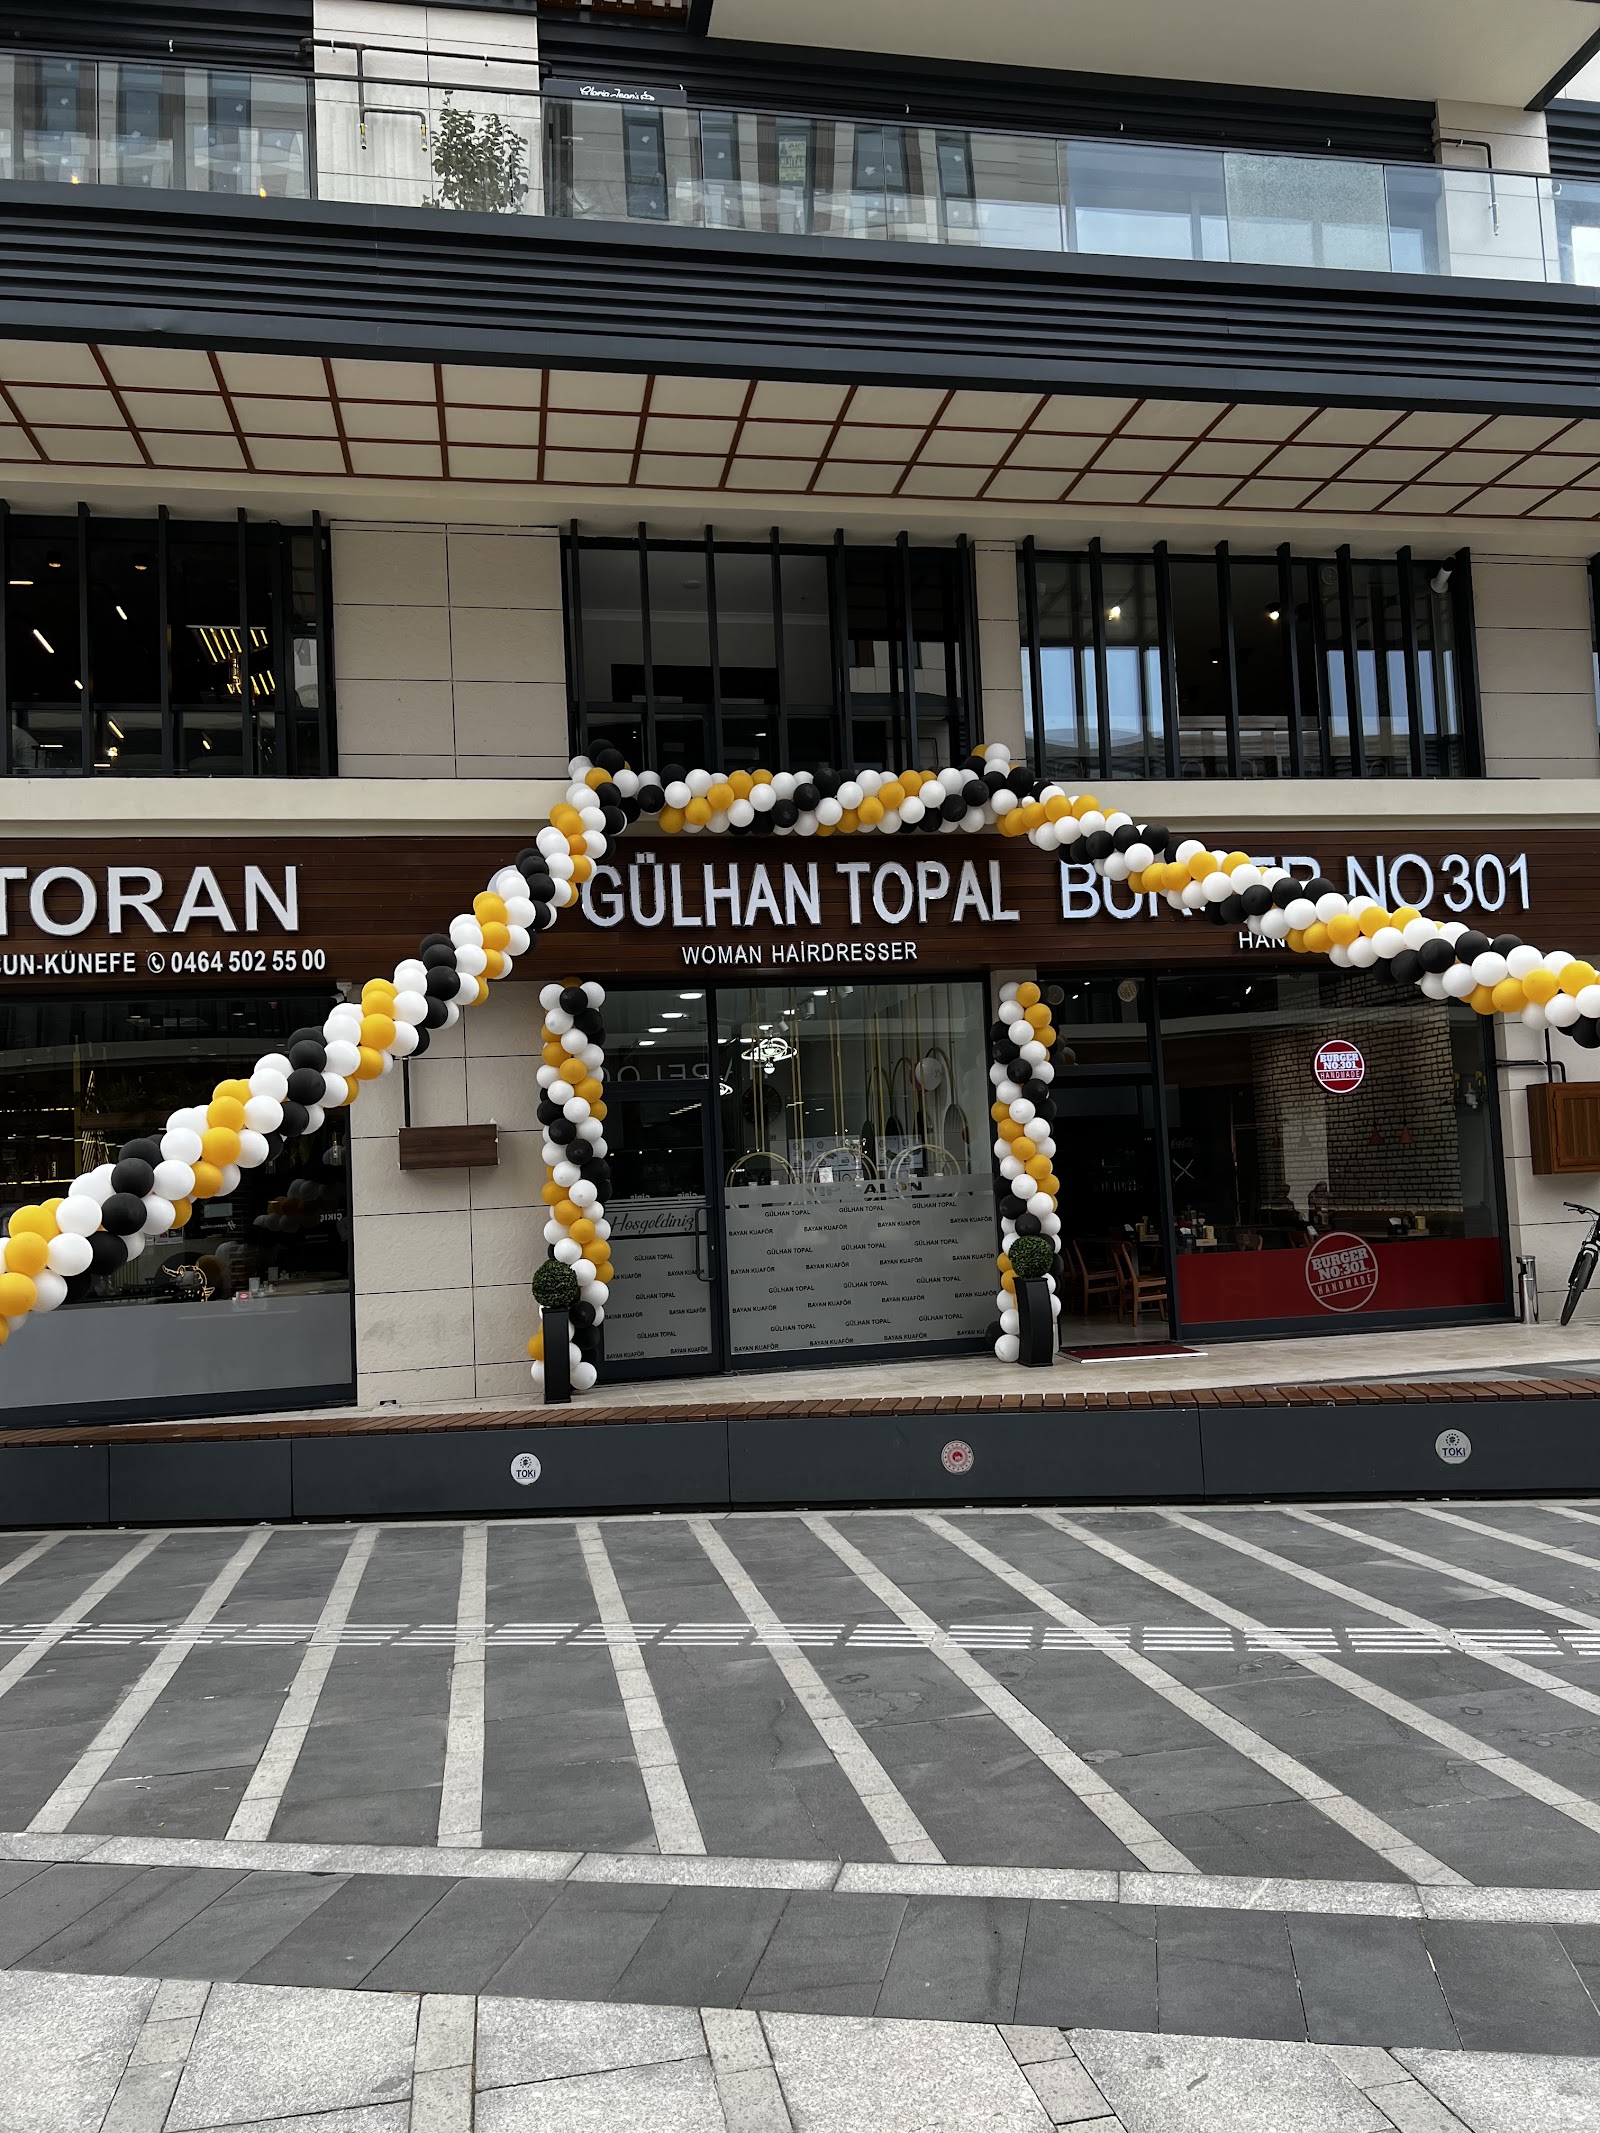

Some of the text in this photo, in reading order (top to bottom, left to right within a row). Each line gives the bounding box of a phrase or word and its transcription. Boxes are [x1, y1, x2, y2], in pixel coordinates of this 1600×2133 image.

[581, 852, 1020, 927] GÜLHAN TOPAL
[1346, 853, 1434, 912] NO
[1440, 853, 1530, 913] 301
[0, 948, 326, 975] UN-KÜNEFE 0464 502 55 00
[682, 944, 762, 965] WOMAN
[1320, 1053, 1359, 1063] BURGER
[1320, 1070, 1361, 1080] HANDMADE
[1311, 1247, 1369, 1271] BURGER
[1317, 1273, 1372, 1295] HANDMADE
